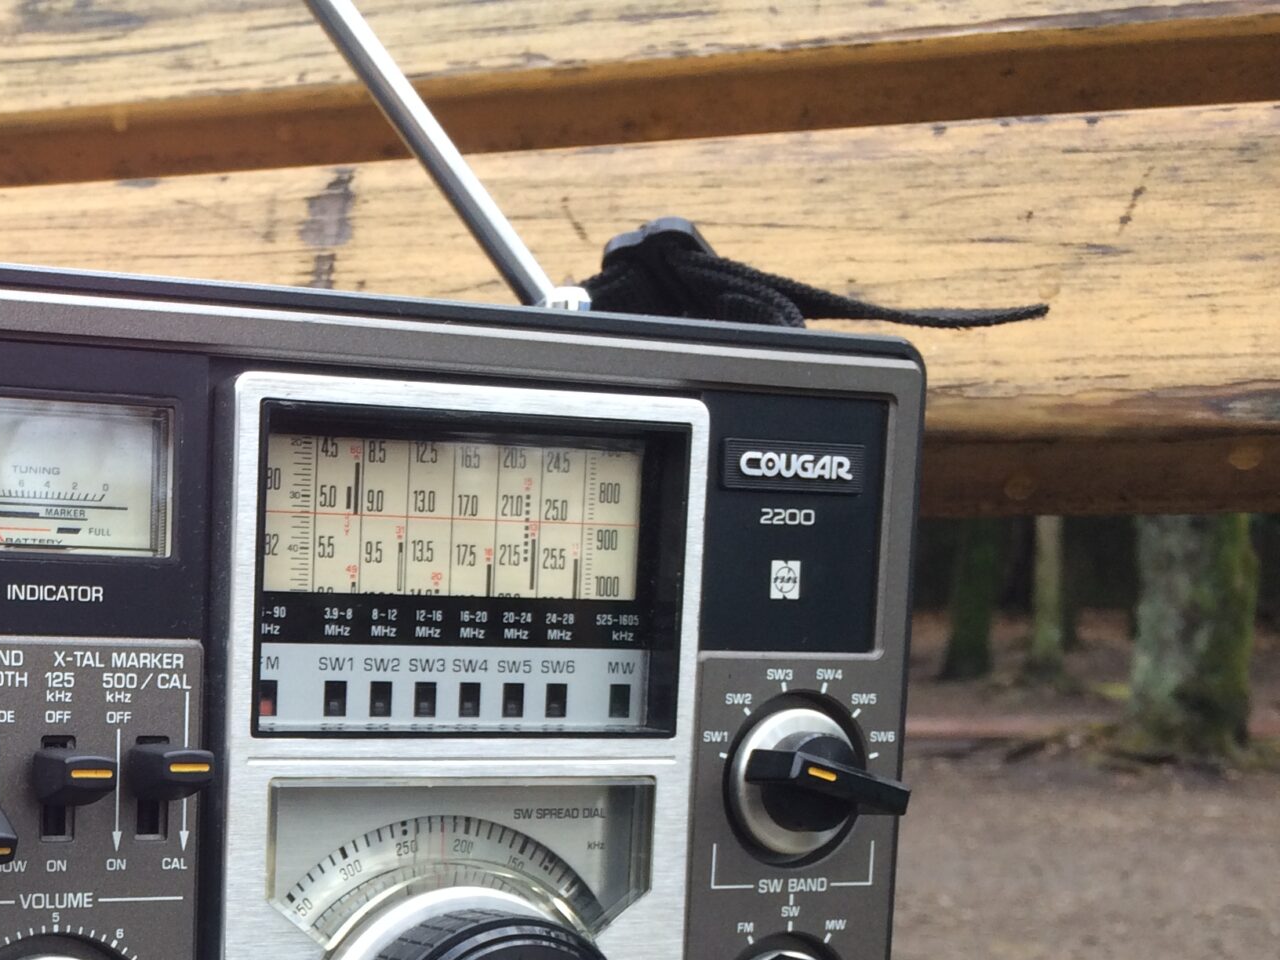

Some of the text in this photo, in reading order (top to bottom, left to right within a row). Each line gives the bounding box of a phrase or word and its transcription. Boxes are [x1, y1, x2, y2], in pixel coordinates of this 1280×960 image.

[321, 437, 338, 458] 4.5
[369, 441, 386, 463] 8.5
[415, 442, 438, 463] 12.5
[460, 448, 480, 469] 16.5
[503, 448, 526, 469] 20.5
[547, 452, 570, 473] 24.5
[739, 451, 853, 480] COUGAR
[12, 465, 61, 475] TUNING
[72, 482, 78, 490] 2
[599, 482, 620, 504] 800
[320, 485, 337, 508] 5.0
[367, 490, 384, 512] 9.0
[413, 491, 436, 512] 13.0
[45, 508, 86, 517] MARKER
[458, 495, 478, 517] 17.0
[501, 495, 523, 517] 21.0
[545, 499, 568, 521] 25.0
[760, 508, 815, 525] 2200
[88, 528, 112, 536] FULL
[596, 529, 618, 551] 900
[318, 536, 335, 558] 5.5
[365, 541, 383, 563] 9.5
[411, 540, 434, 562] 13.5
[456, 544, 476, 566] 17.5
[499, 544, 520, 566] 21.5
[542, 548, 565, 570] 25.5
[7, 584, 104, 602] INDICATOR
[595, 576, 619, 597] 1000
[324, 624, 351, 636] MHz
[371, 625, 397, 637] MHz
[415, 626, 441, 638] MHz
[460, 628, 485, 639] MHz
[504, 628, 529, 640] MHz
[547, 629, 572, 641] MHz
[612, 630, 634, 641] kHz
[54, 652, 184, 669] X-TAL MARKER
[261, 656, 635, 674] M SW1 SW2 SW3 SW4 SW5 SW6 MW
[45, 672, 75, 688] 125
[766, 669, 793, 681] SW3
[816, 668, 843, 681] SW4
[46, 690, 131, 704] kHz kHz
[725, 693, 752, 705] SW2
[851, 693, 877, 705] SW5
[45, 711, 71, 723] OFF
[106, 712, 131, 724] OFF
[703, 731, 729, 742] SW1
[870, 731, 895, 742] SW6
[514, 807, 606, 819] SW SPREAD DIAL
[396, 840, 418, 856] 250
[453, 839, 474, 854] 200
[587, 841, 605, 850] kHz
[46, 860, 67, 872] ON
[106, 859, 127, 871] ON
[162, 858, 188, 870] CAL
[339, 860, 362, 881] 300
[758, 877, 827, 893] SW BAND
[20, 893, 93, 909] VOLUME
[52, 912, 60, 922] 5
[781, 906, 800, 918] SW
[737, 921, 754, 933] FM
[825, 918, 847, 930] MW
[116, 929, 124, 939] 6
